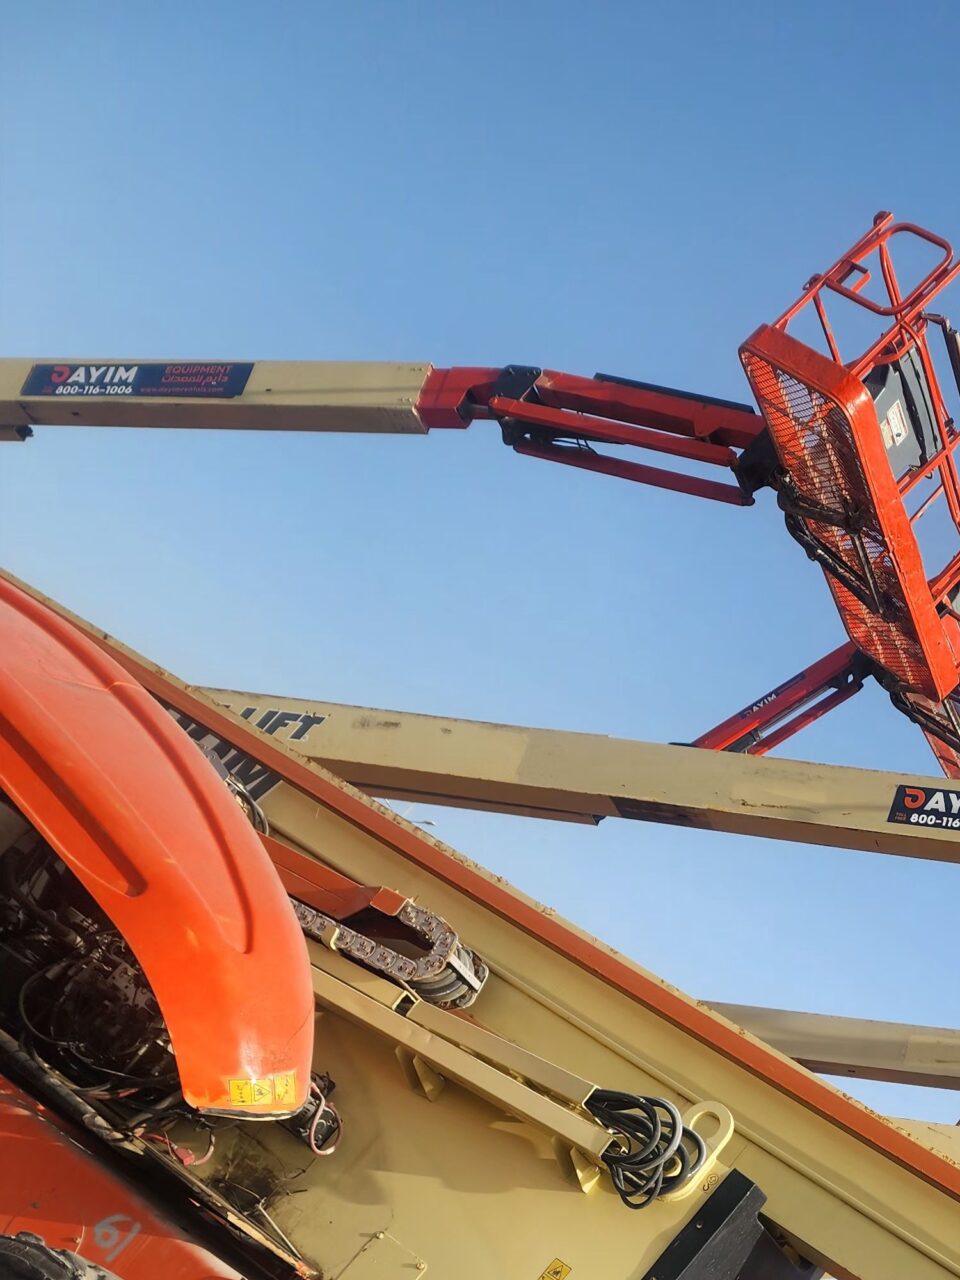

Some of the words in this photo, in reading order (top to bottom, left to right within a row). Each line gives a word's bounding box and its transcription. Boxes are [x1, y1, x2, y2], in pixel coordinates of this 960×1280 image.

[51, 365, 138, 383] DAYIM
[164, 365, 232, 375] EQUIPMENT
[55, 385, 133, 395] 800-116-1006
